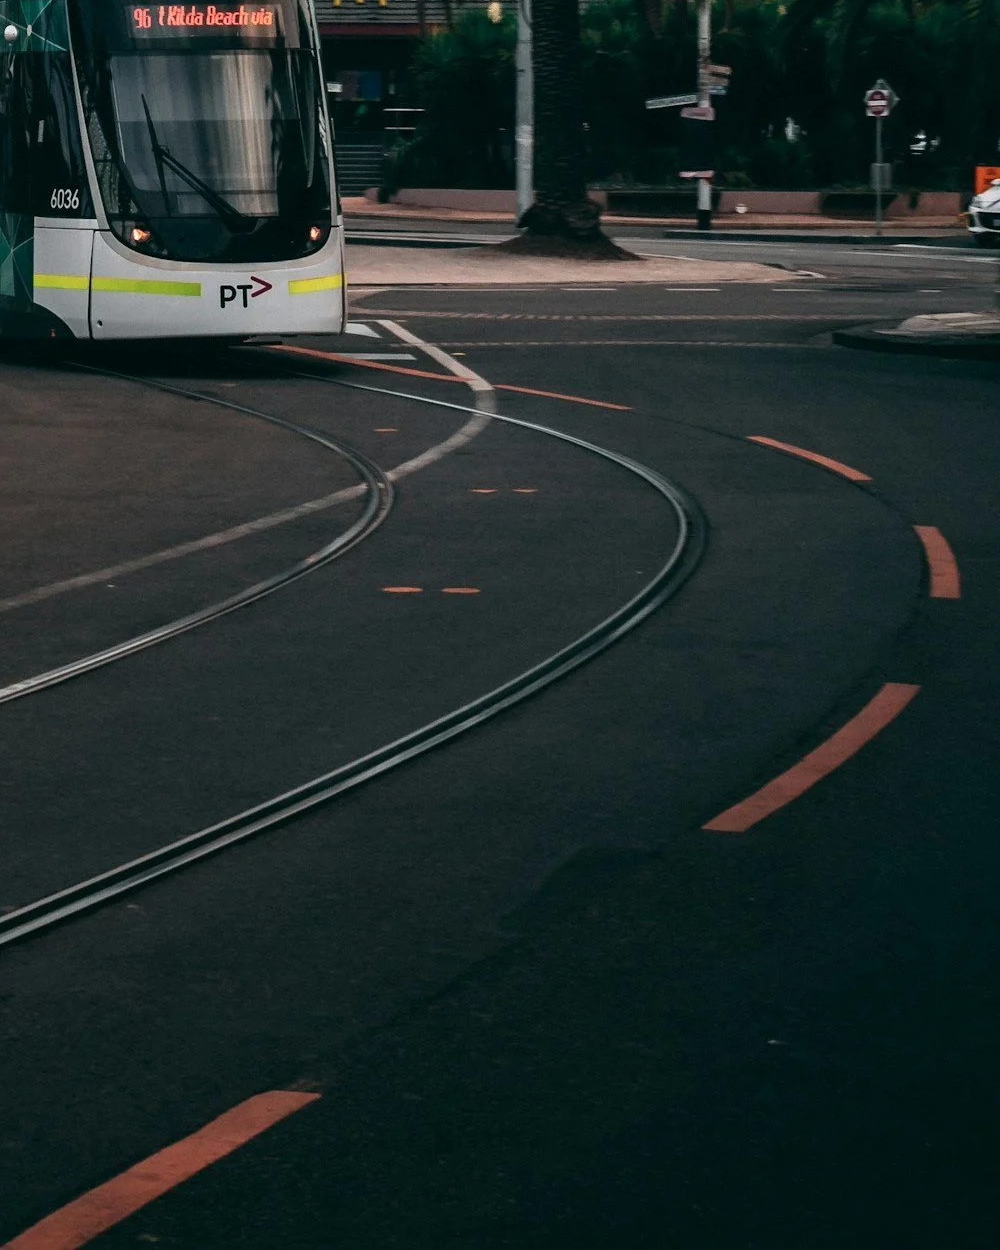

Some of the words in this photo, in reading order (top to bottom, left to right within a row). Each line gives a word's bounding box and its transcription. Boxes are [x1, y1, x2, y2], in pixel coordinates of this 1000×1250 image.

[133, 8, 151, 29] 96
[167, 5, 203, 26] Kilda
[206, 5, 248, 26] Beach
[251, 7, 273, 26] via
[50, 188, 80, 210] 6036
